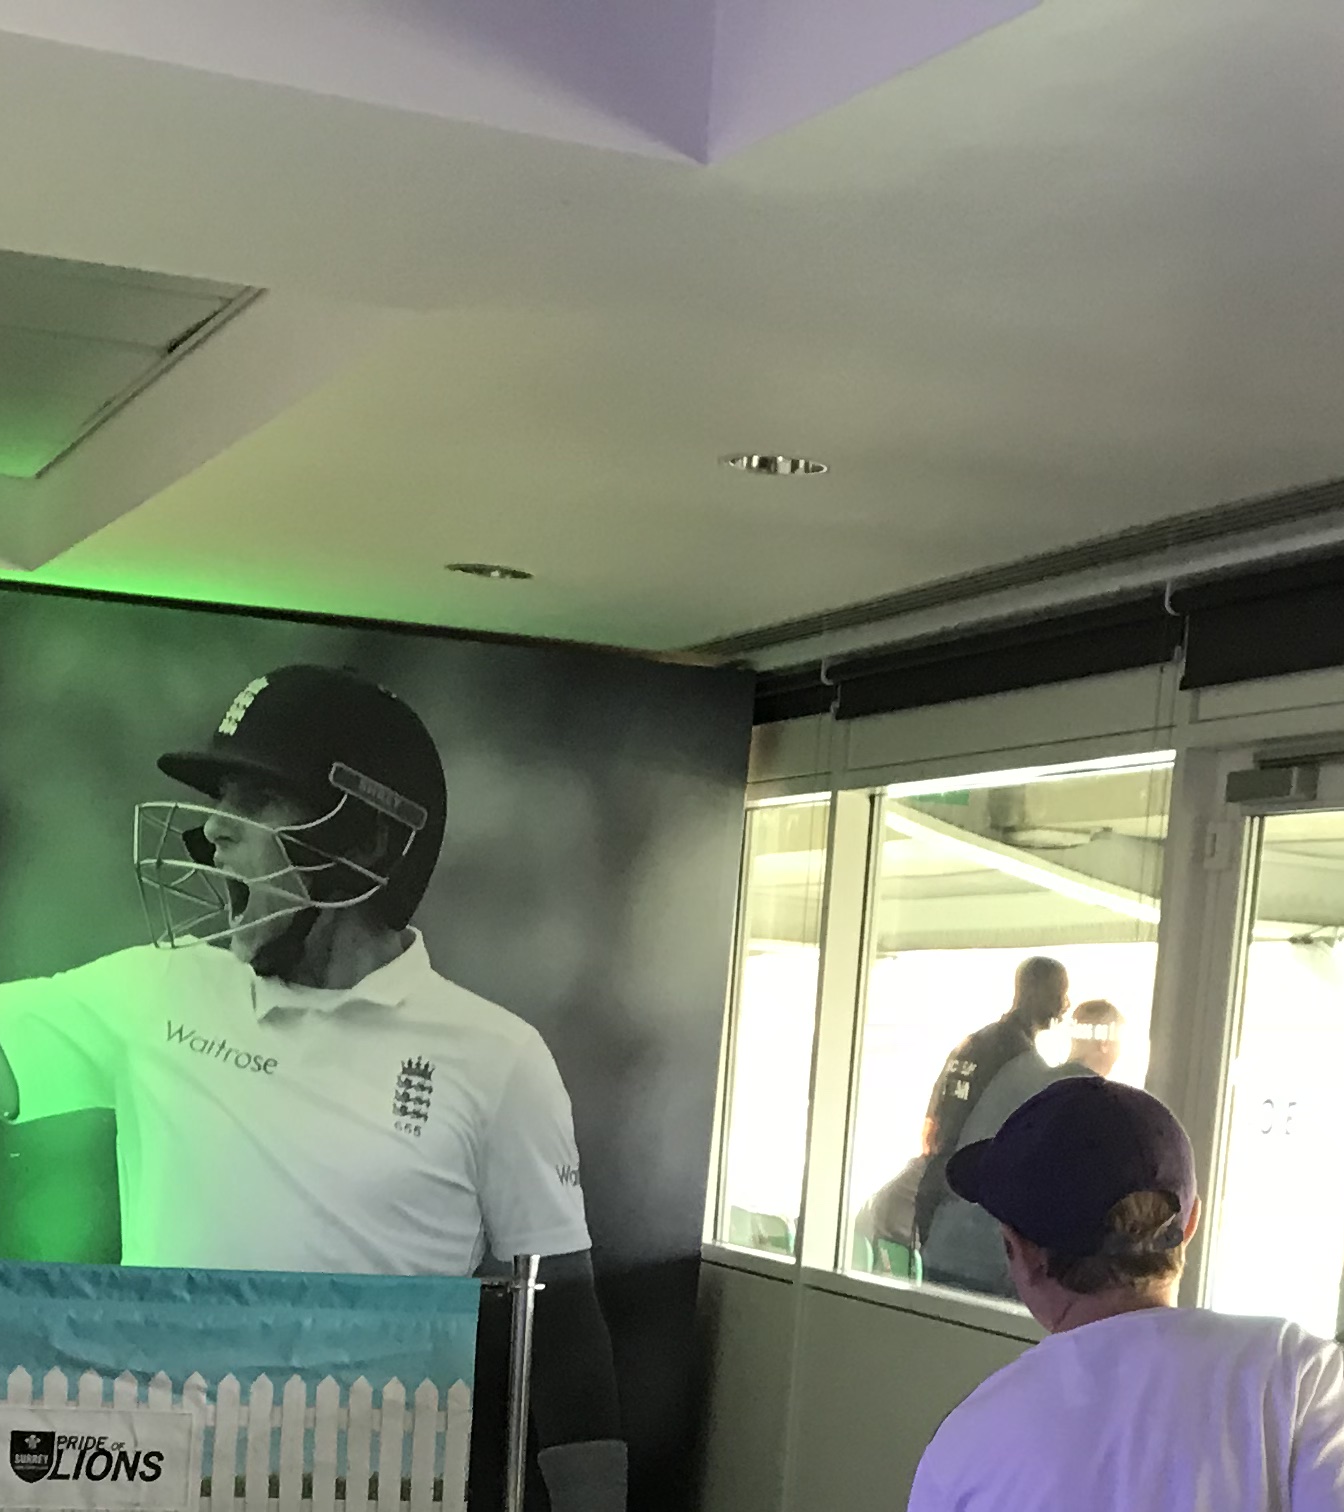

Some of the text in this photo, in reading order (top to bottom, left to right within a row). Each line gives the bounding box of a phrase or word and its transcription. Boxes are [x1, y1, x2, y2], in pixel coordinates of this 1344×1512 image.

[165, 1019, 279, 1076] Waitrose
[57, 1435, 126, 1452] PRIDE OF
[46, 1450, 165, 1483] LIONS
